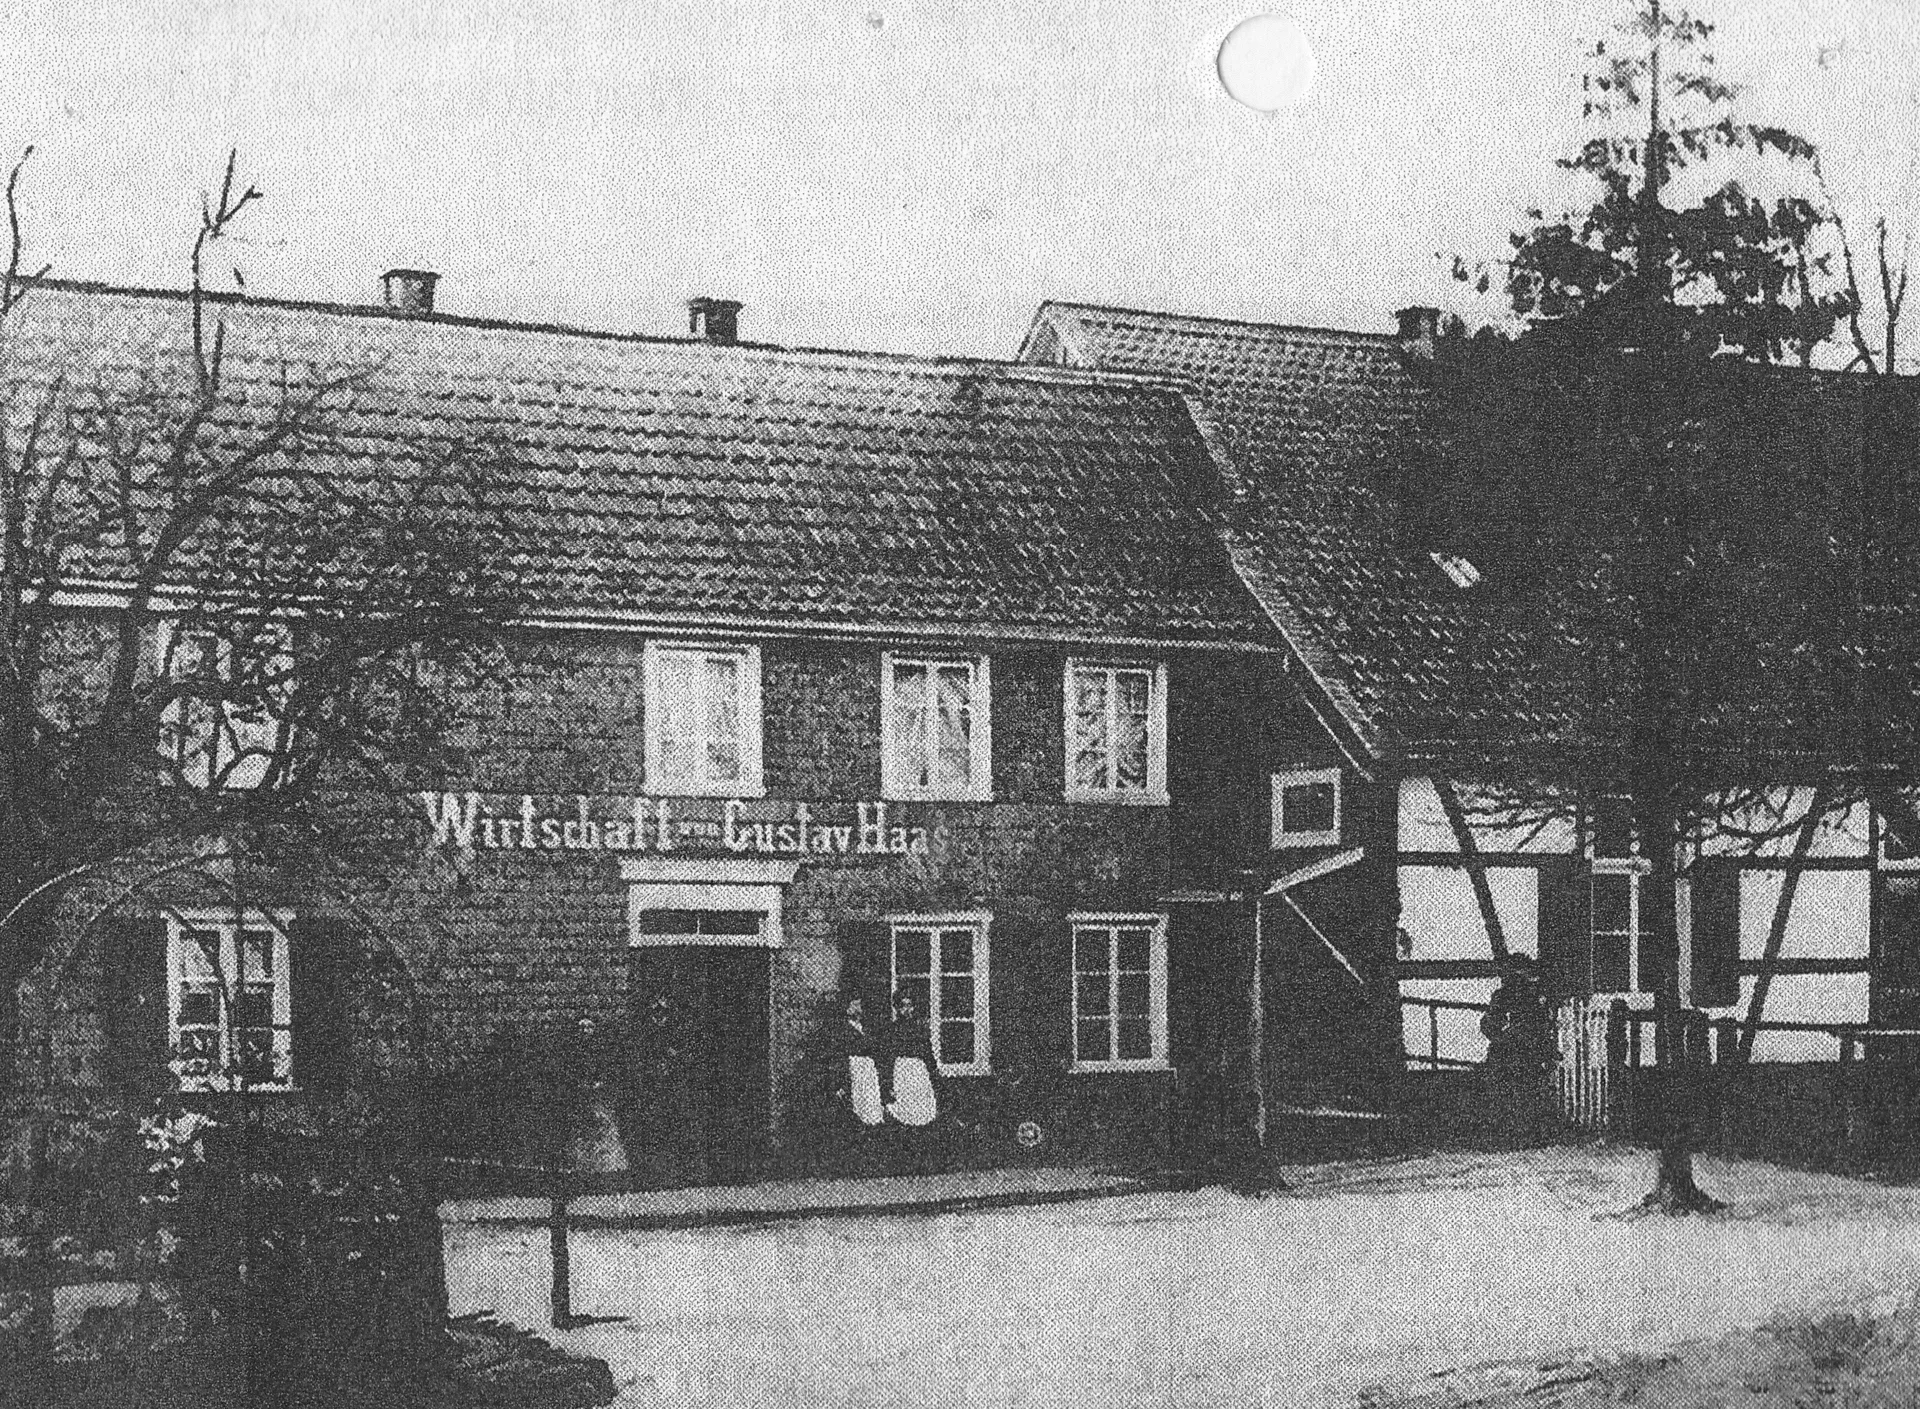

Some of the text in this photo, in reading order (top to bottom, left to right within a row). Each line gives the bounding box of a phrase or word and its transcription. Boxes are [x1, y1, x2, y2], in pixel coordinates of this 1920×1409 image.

[420, 790, 674, 850] Wirtschaft
[724, 799, 851, 853] Gustav
[857, 801, 950, 854] Haas
